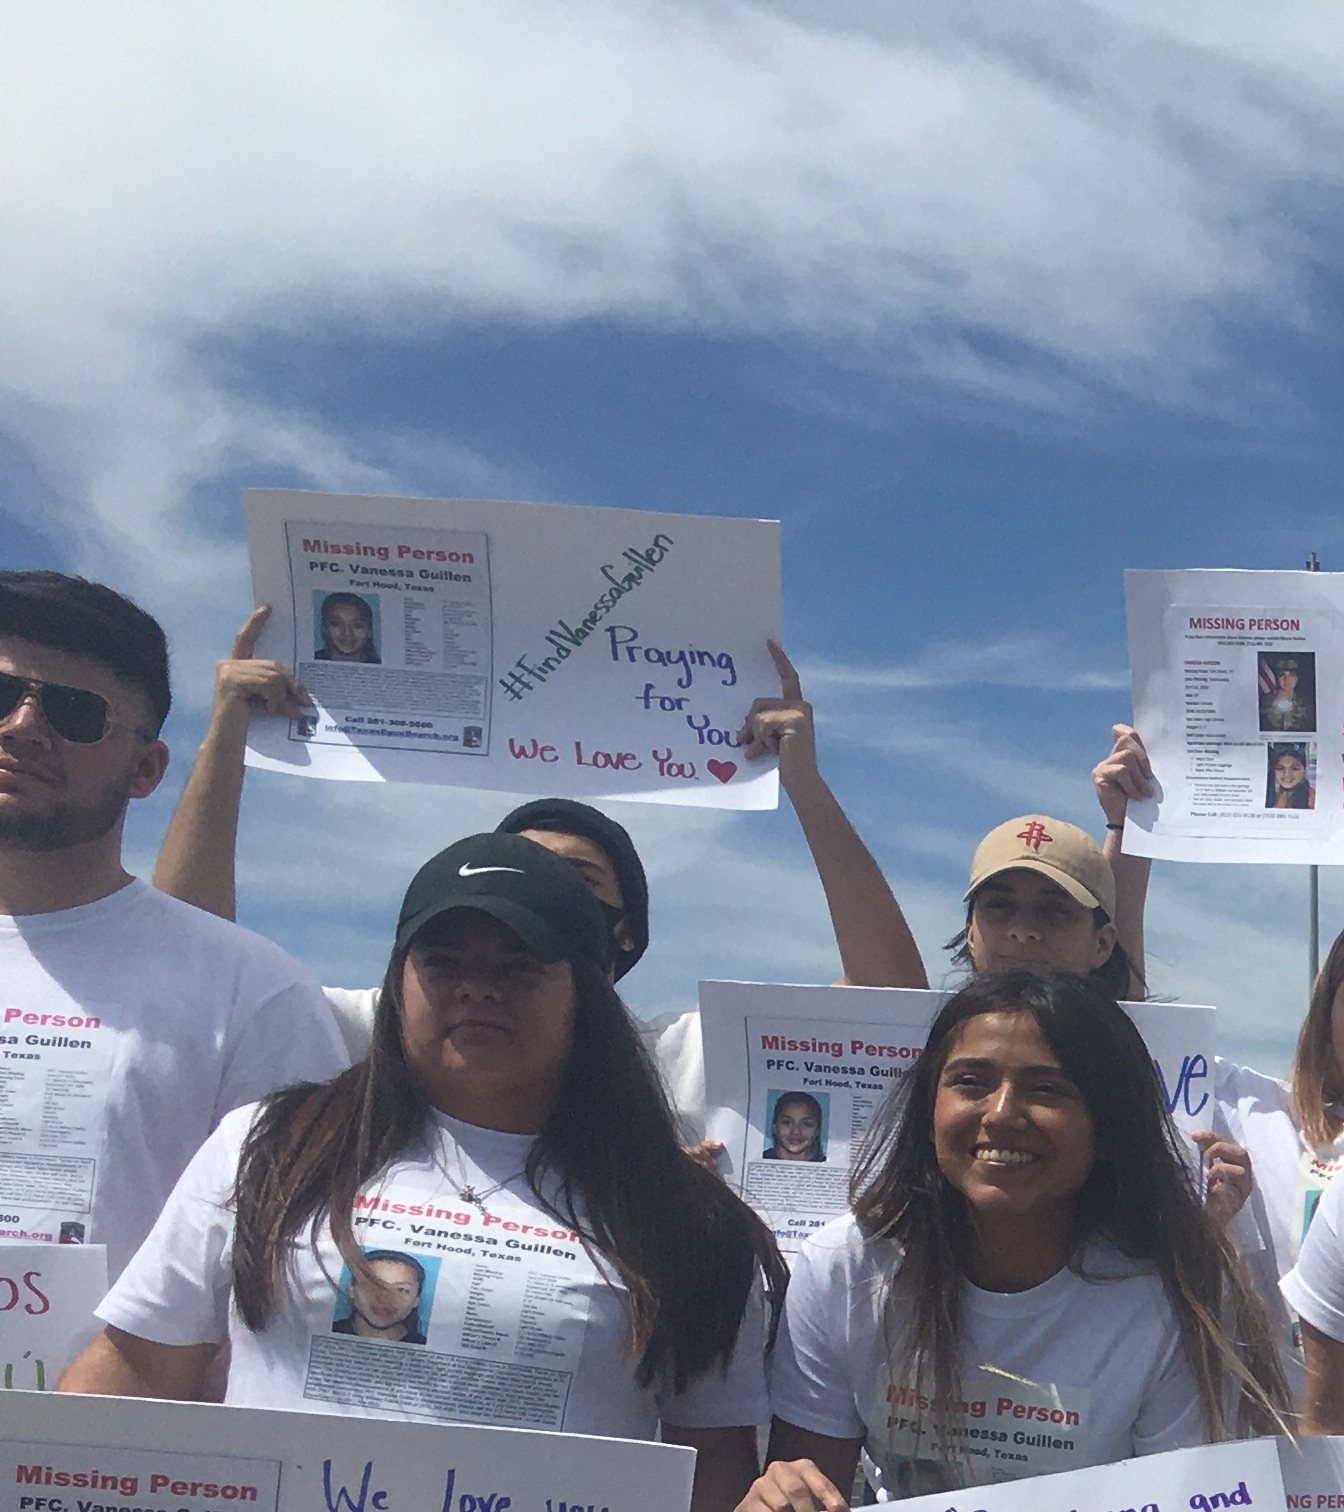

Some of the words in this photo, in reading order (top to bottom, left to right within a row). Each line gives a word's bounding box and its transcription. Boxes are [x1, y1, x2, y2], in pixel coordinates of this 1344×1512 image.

[303, 538, 389, 561] Missing
[397, 545, 475, 565] Person
[1189, 617, 1245, 631] MISSING
[1249, 618, 1300, 631] PERSON
[605, 625, 738, 689] Praying
[635, 684, 690, 712] for
[686, 715, 741, 746] You
[508, 738, 559, 762] We
[576, 743, 642, 771] Love
[761, 1034, 844, 1057] Missing
[850, 1040, 924, 1059] Person
[16, 1464, 138, 1496] Missing
[149, 1474, 258, 1501] Person
[1188, 1482, 1252, 1512] and
